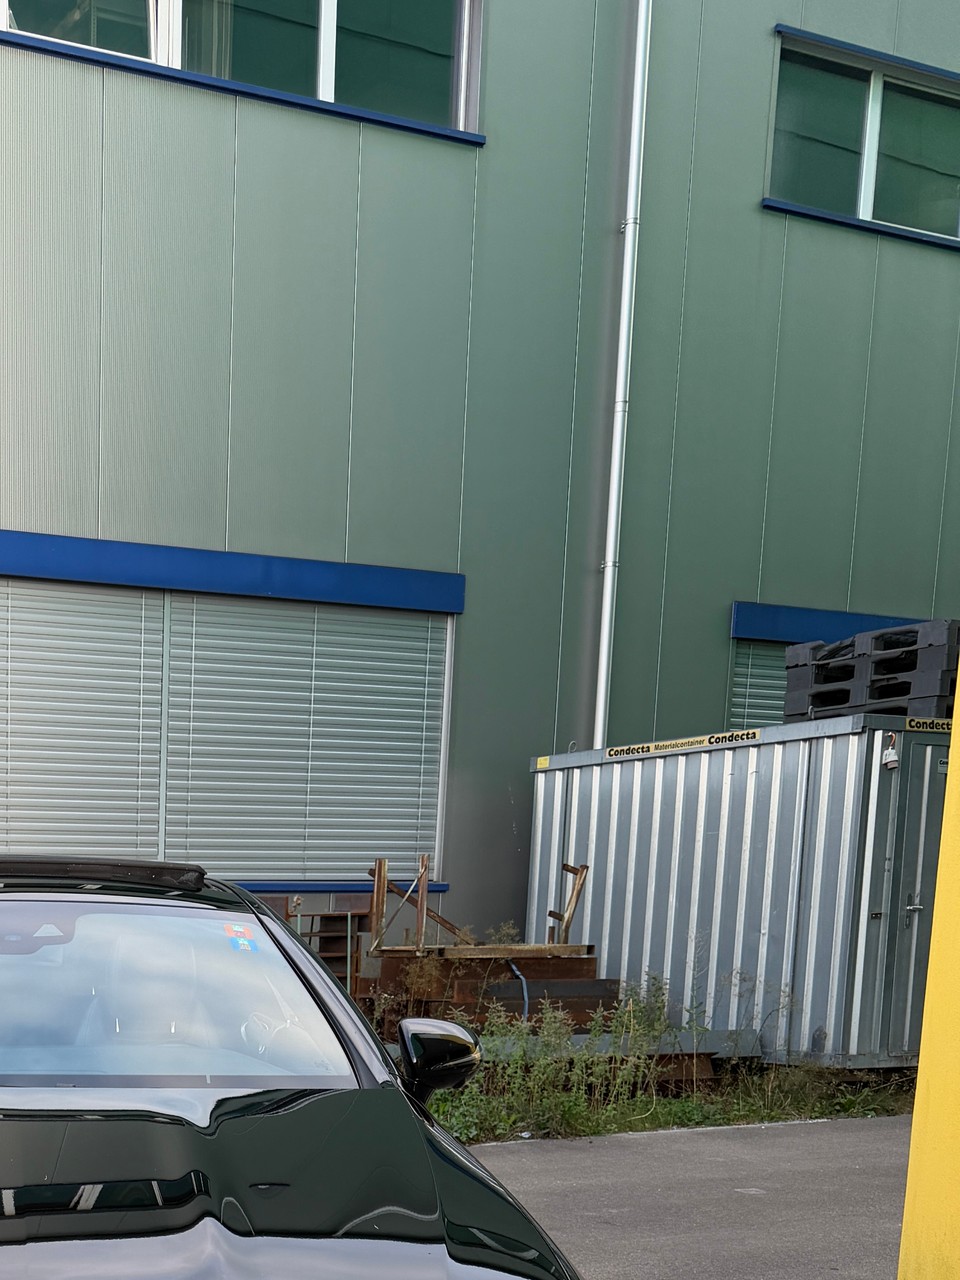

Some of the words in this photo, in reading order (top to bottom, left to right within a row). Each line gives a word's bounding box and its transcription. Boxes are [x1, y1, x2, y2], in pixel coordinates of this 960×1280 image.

[908, 718, 952, 730] Condect
[608, 745, 651, 757] Condecta
[653, 738, 706, 751] Materialcontainer
[708, 730, 757, 745] Condecta
